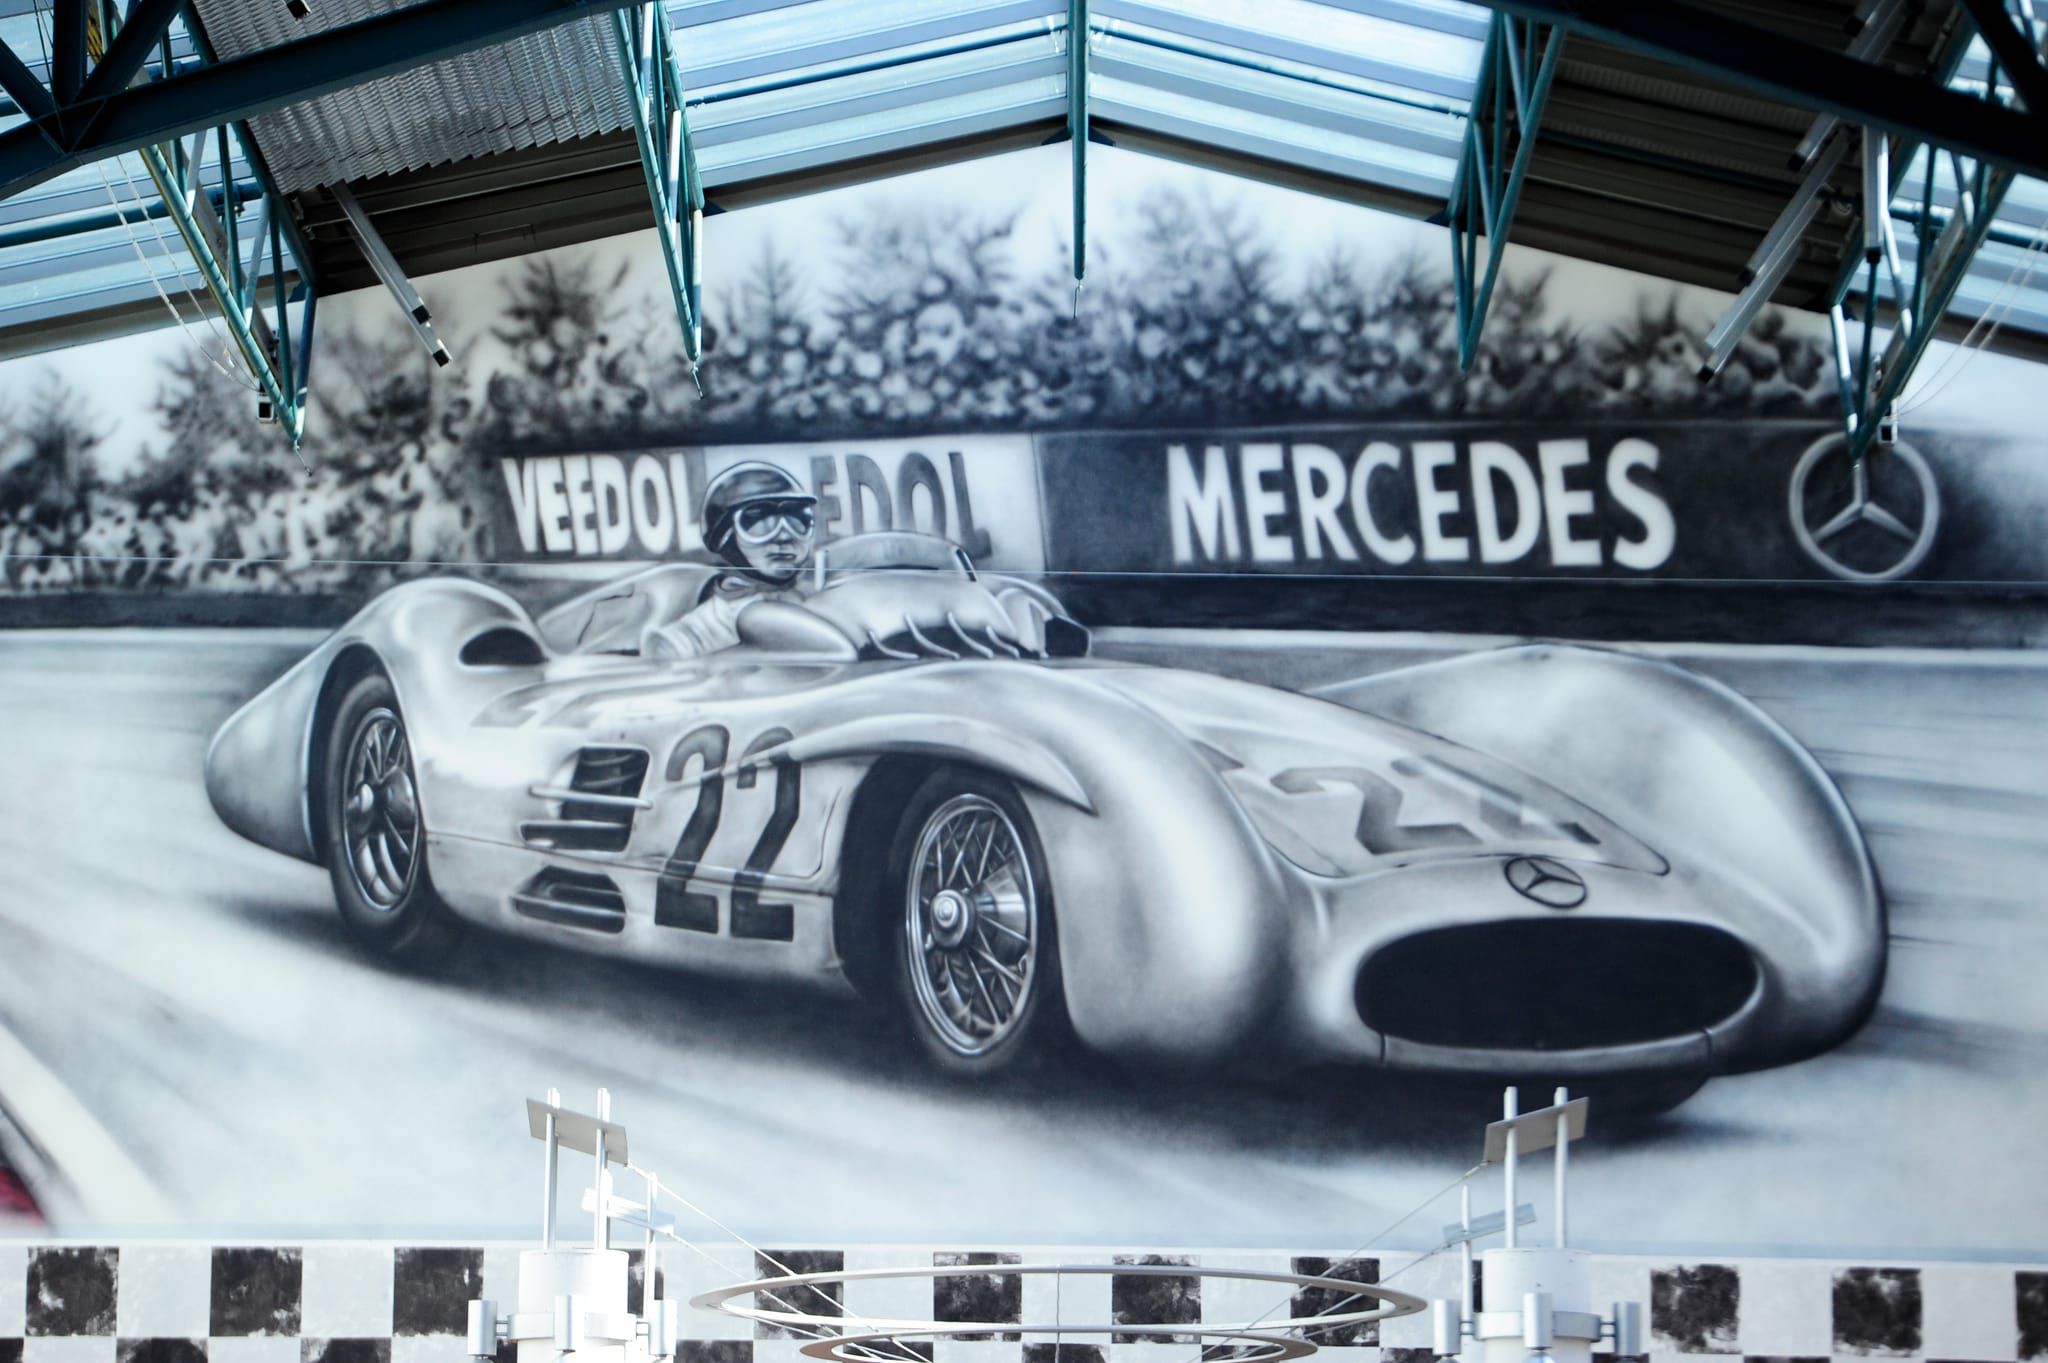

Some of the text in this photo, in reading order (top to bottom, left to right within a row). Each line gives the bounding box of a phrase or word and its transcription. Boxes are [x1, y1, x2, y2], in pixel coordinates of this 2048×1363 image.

[502, 452, 704, 555] VEEDOL
[808, 450, 993, 560] EDOL
[1166, 437, 1677, 571] MERCEDES
[655, 723, 802, 943] 22
